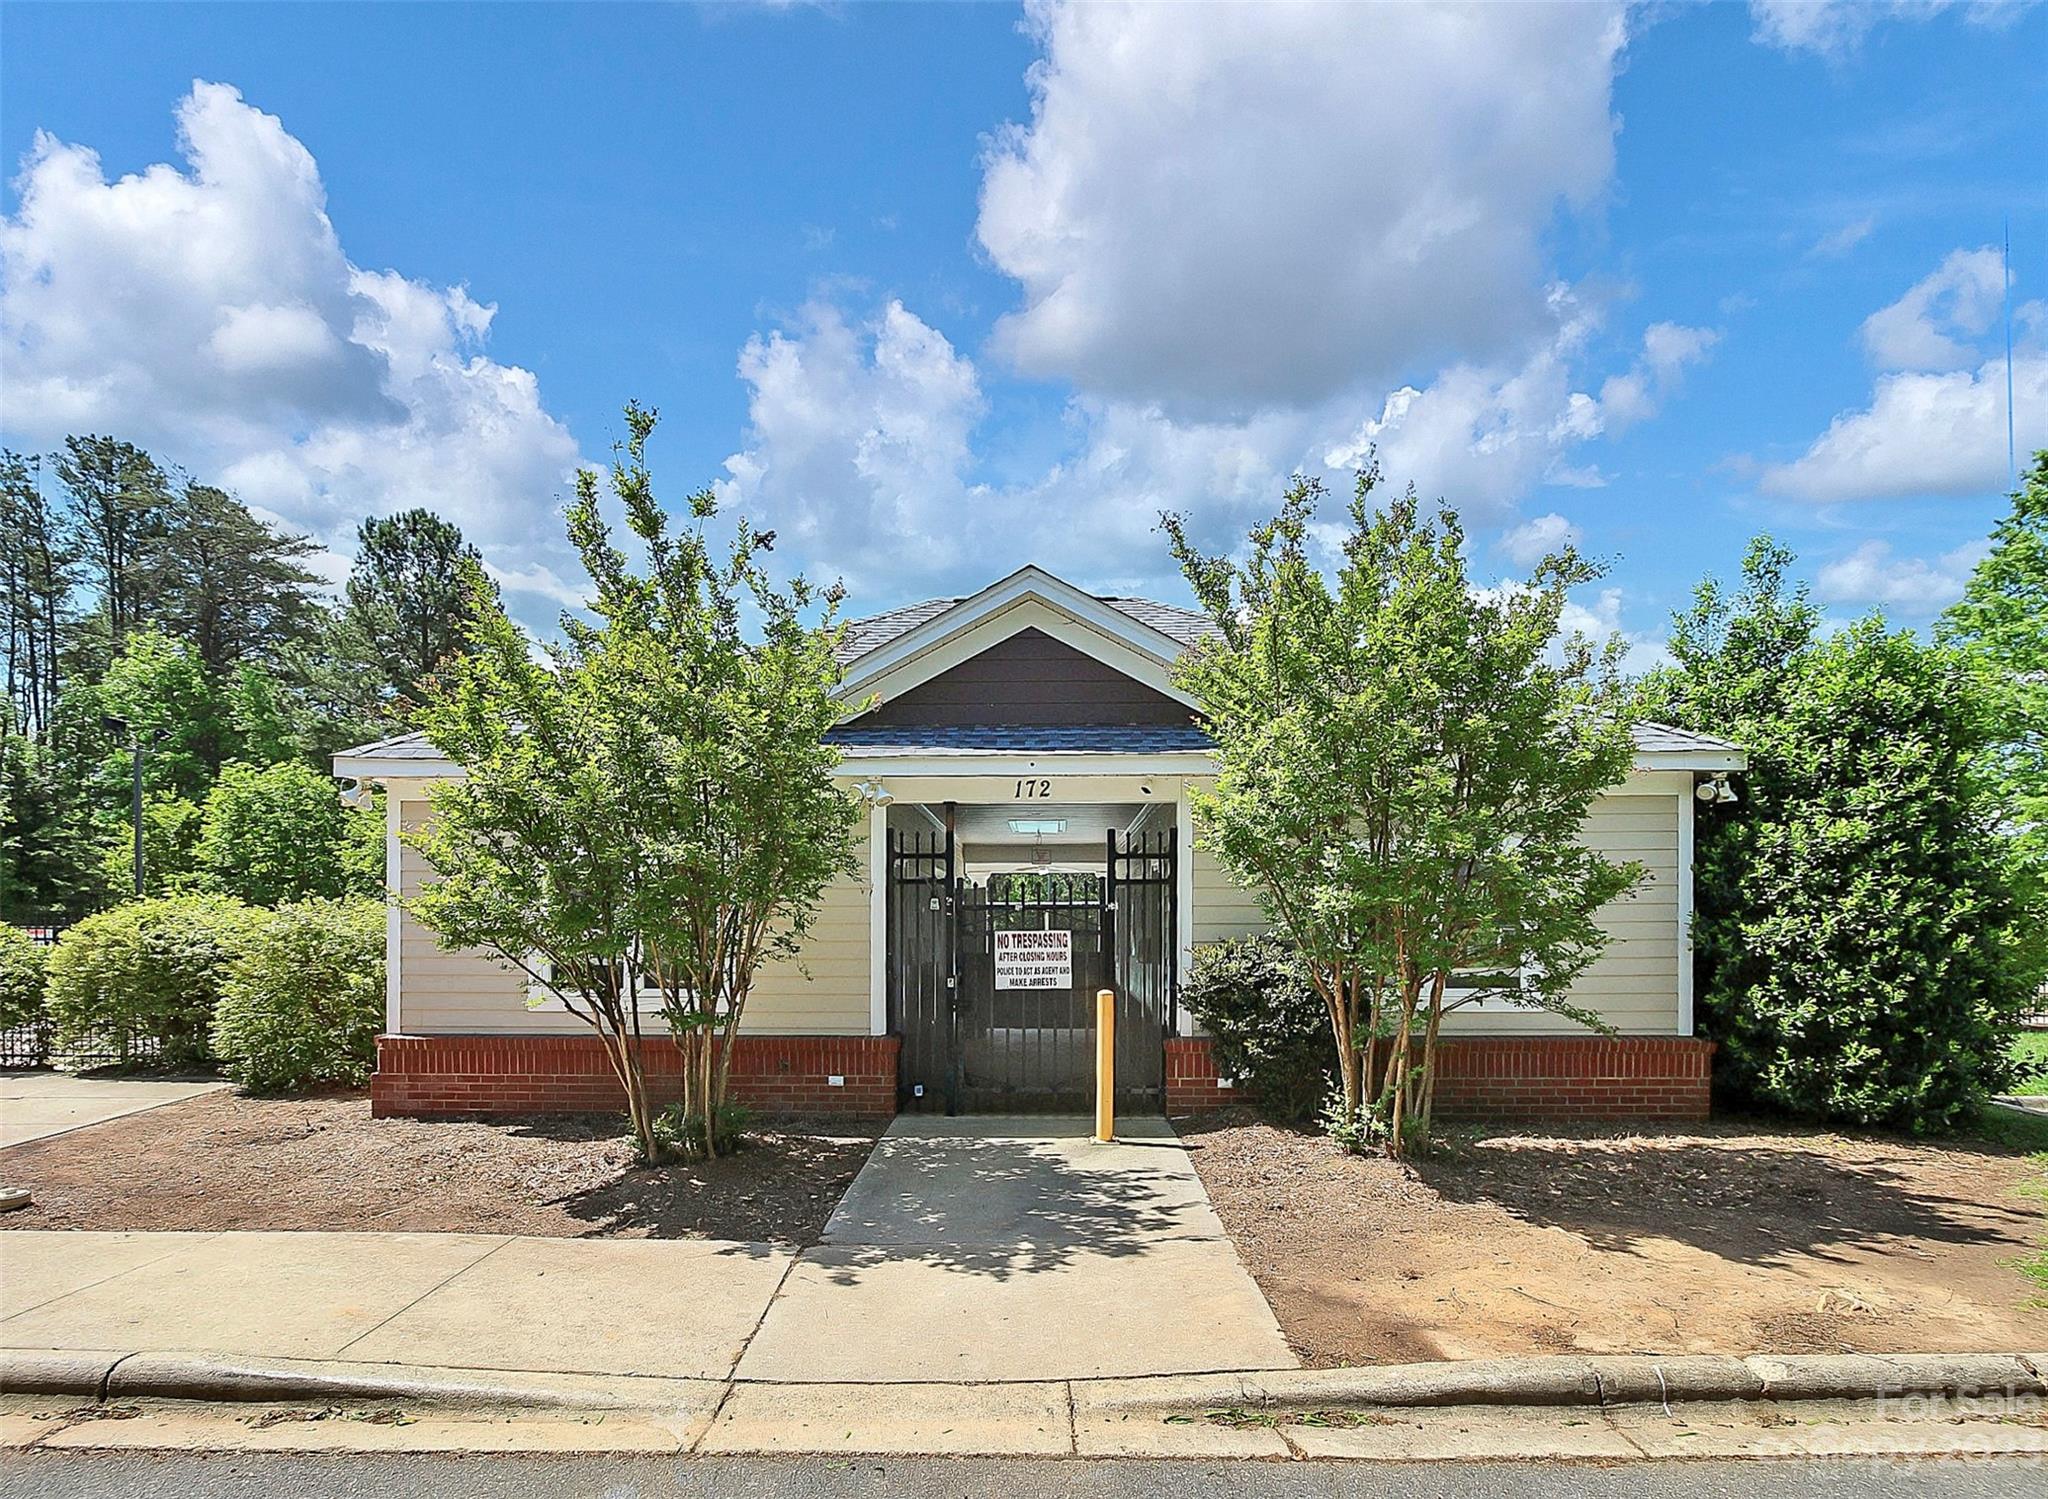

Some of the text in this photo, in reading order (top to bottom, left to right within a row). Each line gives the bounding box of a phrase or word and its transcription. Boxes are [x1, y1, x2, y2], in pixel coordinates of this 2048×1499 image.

[1015, 779, 1050, 798] 172
[997, 933, 1068, 949] NO TRESPASSING
[999, 951, 1068, 962] AFTER CLOSING HOURS
[997, 966, 1070, 976] POLICE TO ACT AS AGENT AND
[1009, 977, 1058, 987] MAKE ARRESTS
